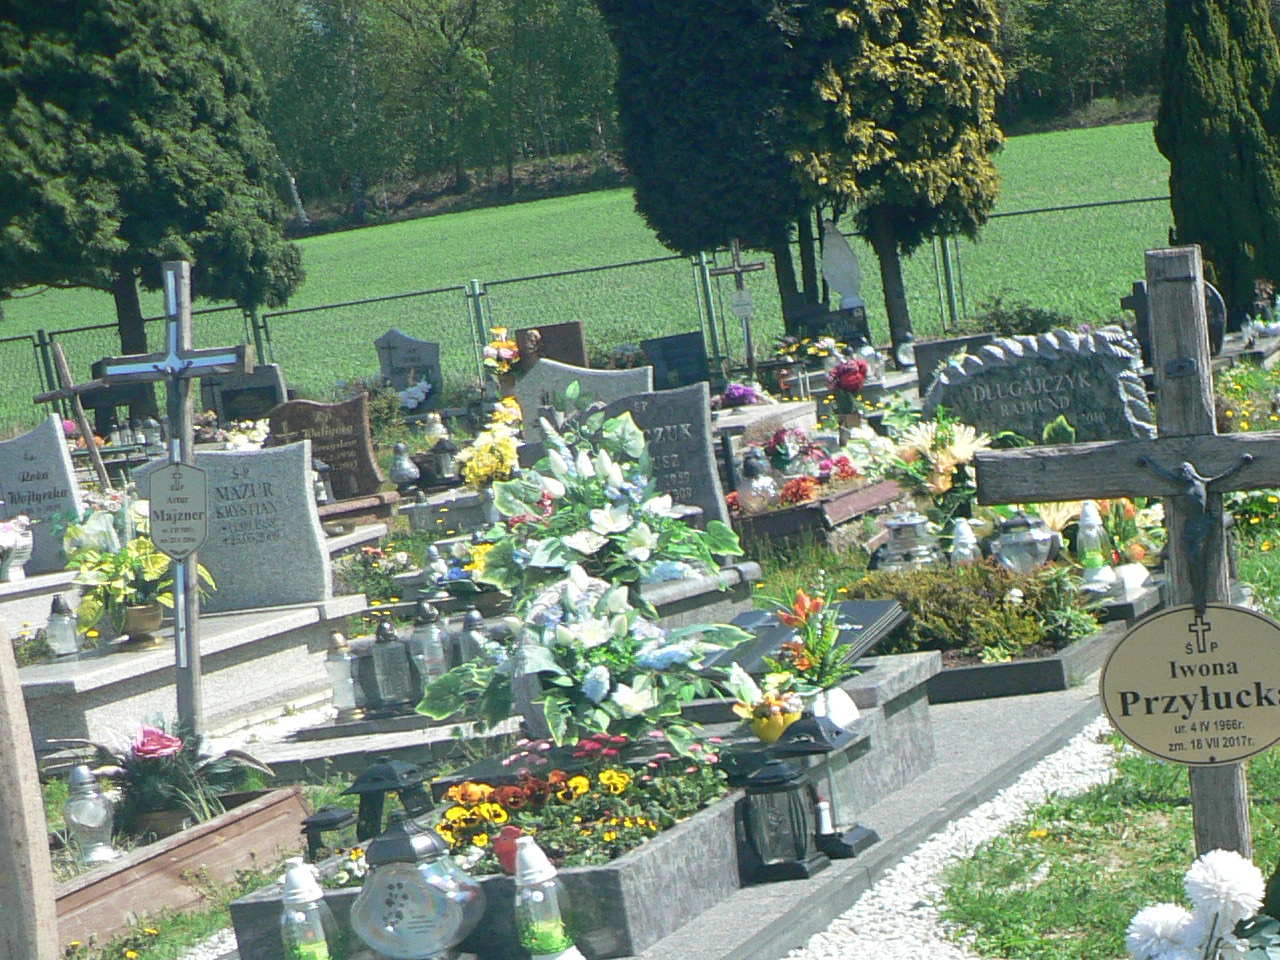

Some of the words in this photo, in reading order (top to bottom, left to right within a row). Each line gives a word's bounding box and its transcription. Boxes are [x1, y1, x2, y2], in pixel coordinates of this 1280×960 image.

[215, 482, 274, 501] MAZUR
[167, 496, 190, 504] Artur
[153, 509, 205, 524] Majzner
[216, 502, 278, 519] KRYSTIAN
[1210, 642, 1218, 652] P
[1169, 661, 1239, 678] Iwona
[1174, 725, 1188, 734] ur.
[1190, 722, 1197, 732] 4
[1200, 720, 1210, 732] IV
[1168, 742, 1187, 752] zm.
[1206, 737, 1219, 749] VII
[1223, 735, 1255, 748] 2017r.
